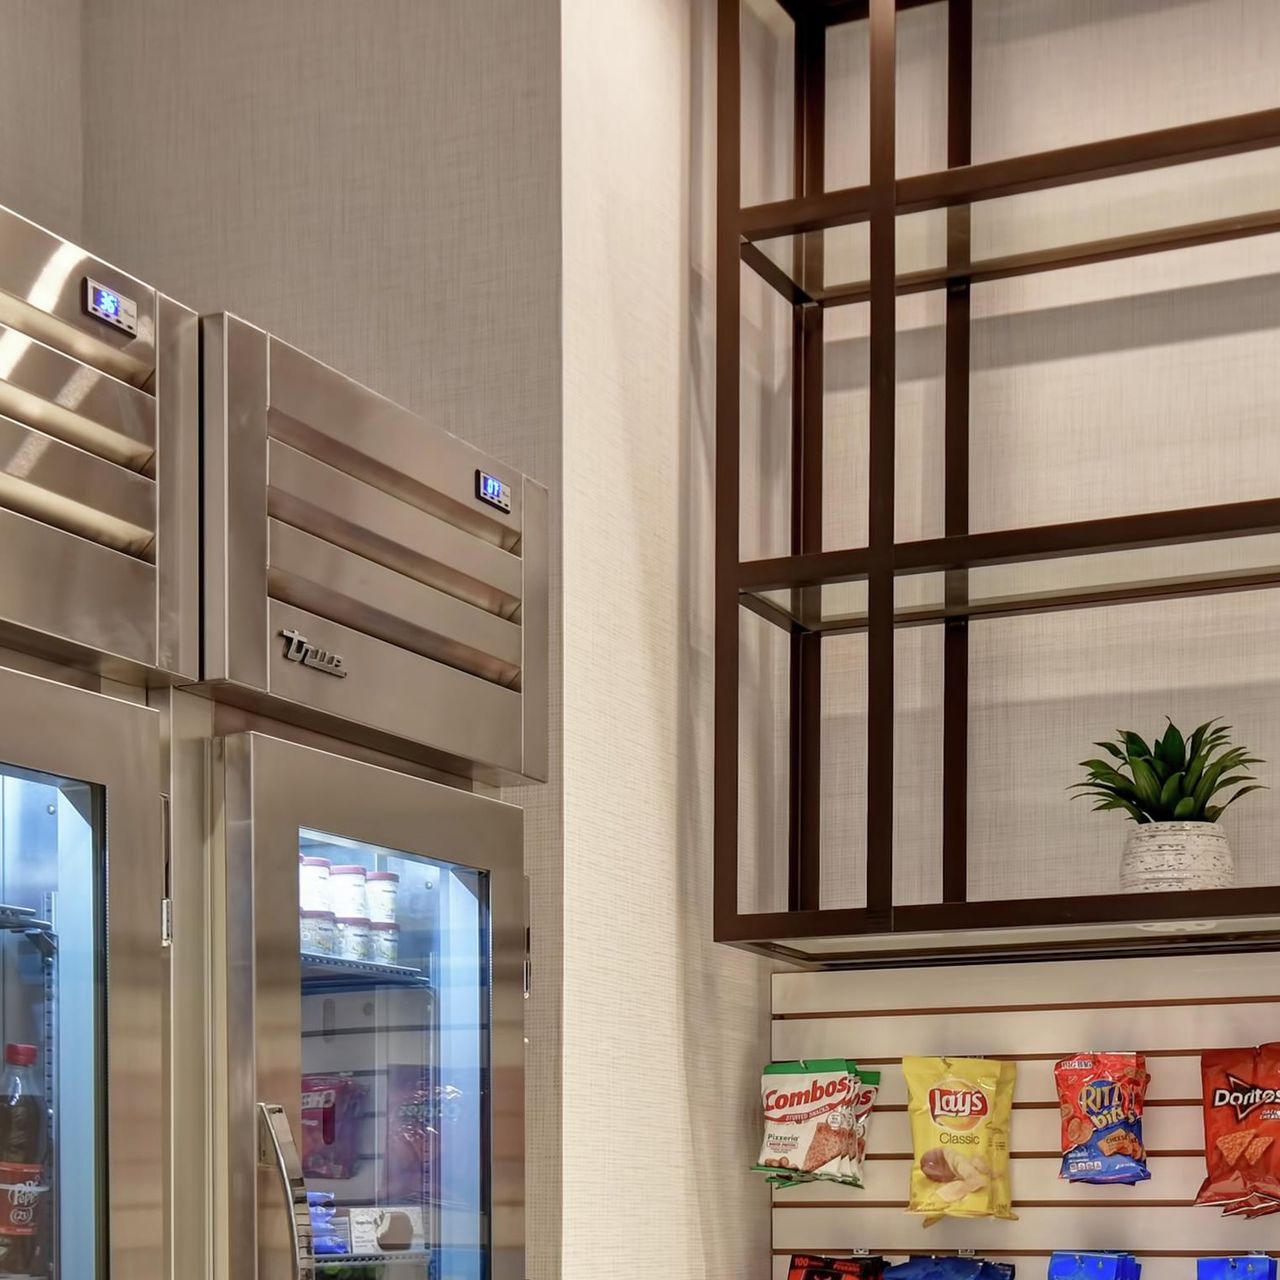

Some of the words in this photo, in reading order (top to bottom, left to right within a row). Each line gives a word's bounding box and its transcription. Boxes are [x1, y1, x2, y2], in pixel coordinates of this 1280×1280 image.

[765, 1077, 849, 1111] Combos
[934, 1089, 983, 1116] Lay's
[939, 1132, 980, 1145] Classic
